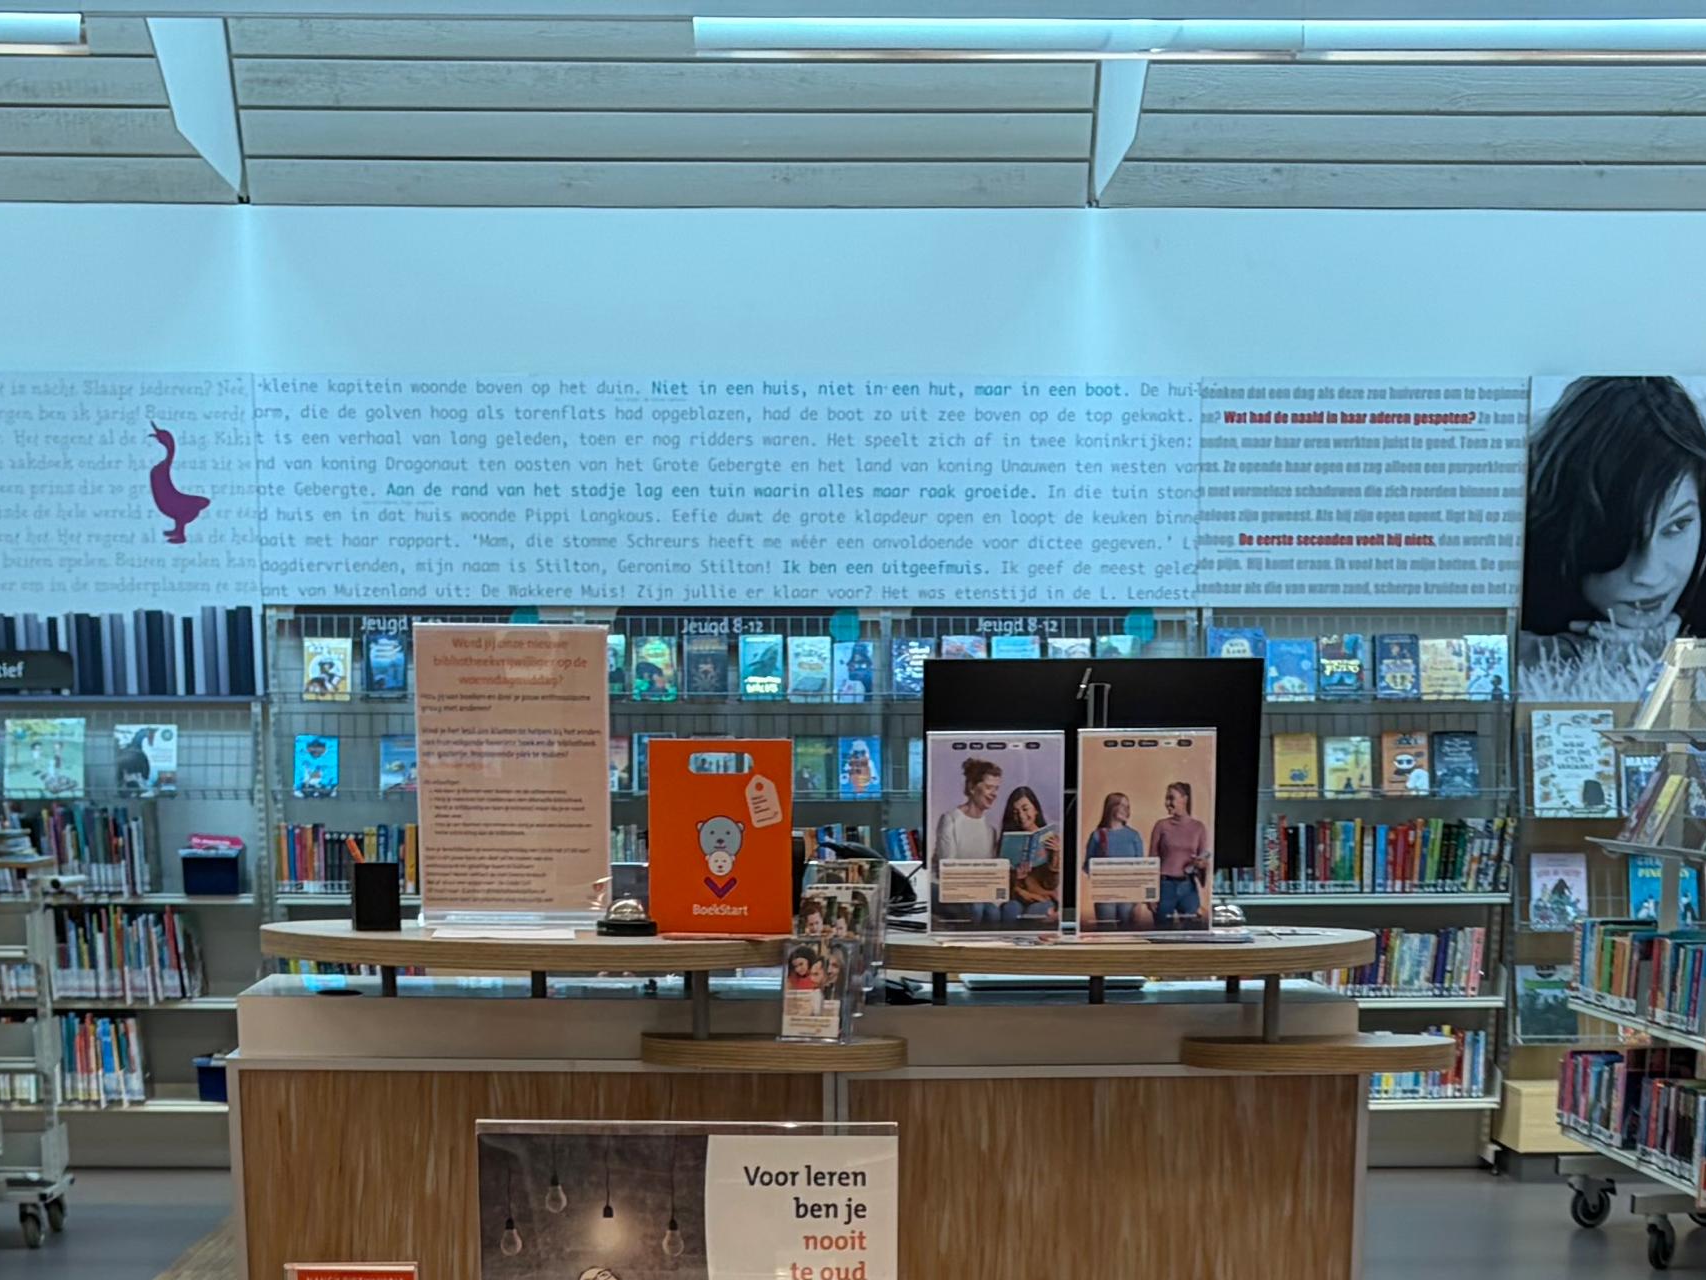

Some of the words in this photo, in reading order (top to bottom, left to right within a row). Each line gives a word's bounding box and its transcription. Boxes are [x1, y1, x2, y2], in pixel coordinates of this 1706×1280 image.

[651, 380, 689, 396] Niet
[698, 380, 717, 396] in
[725, 383, 755, 396] een
[762, 380, 807, 399] huis,
[817, 380, 855, 397] niet
[865, 380, 884, 396] in
[891, 384, 920, 397] een
[928, 381, 964, 399] hut,
[974, 384, 1013, 397] maar
[1021, 382, 1040, 397] in
[1048, 385, 1077, 397] een
[1085, 382, 1129, 397] boot.
[1223, 411, 1247, 424] Wat
[1249, 410, 1272, 424] had
[1274, 411, 1289, 424] de
[1326, 411, 1338, 424] in
[681, 618, 730, 637] Jeugd
[732, 619, 763, 634] 8-12
[977, 618, 1024, 637] Jeugd
[1026, 619, 1060, 634] 8-12
[692, 903, 749, 917] BoekStart
[743, 1165, 800, 1187] Voor
[804, 1164, 867, 1187] leren
[792, 1196, 838, 1219] ben
[843, 1197, 867, 1225] je
[802, 1229, 867, 1251] nooit
